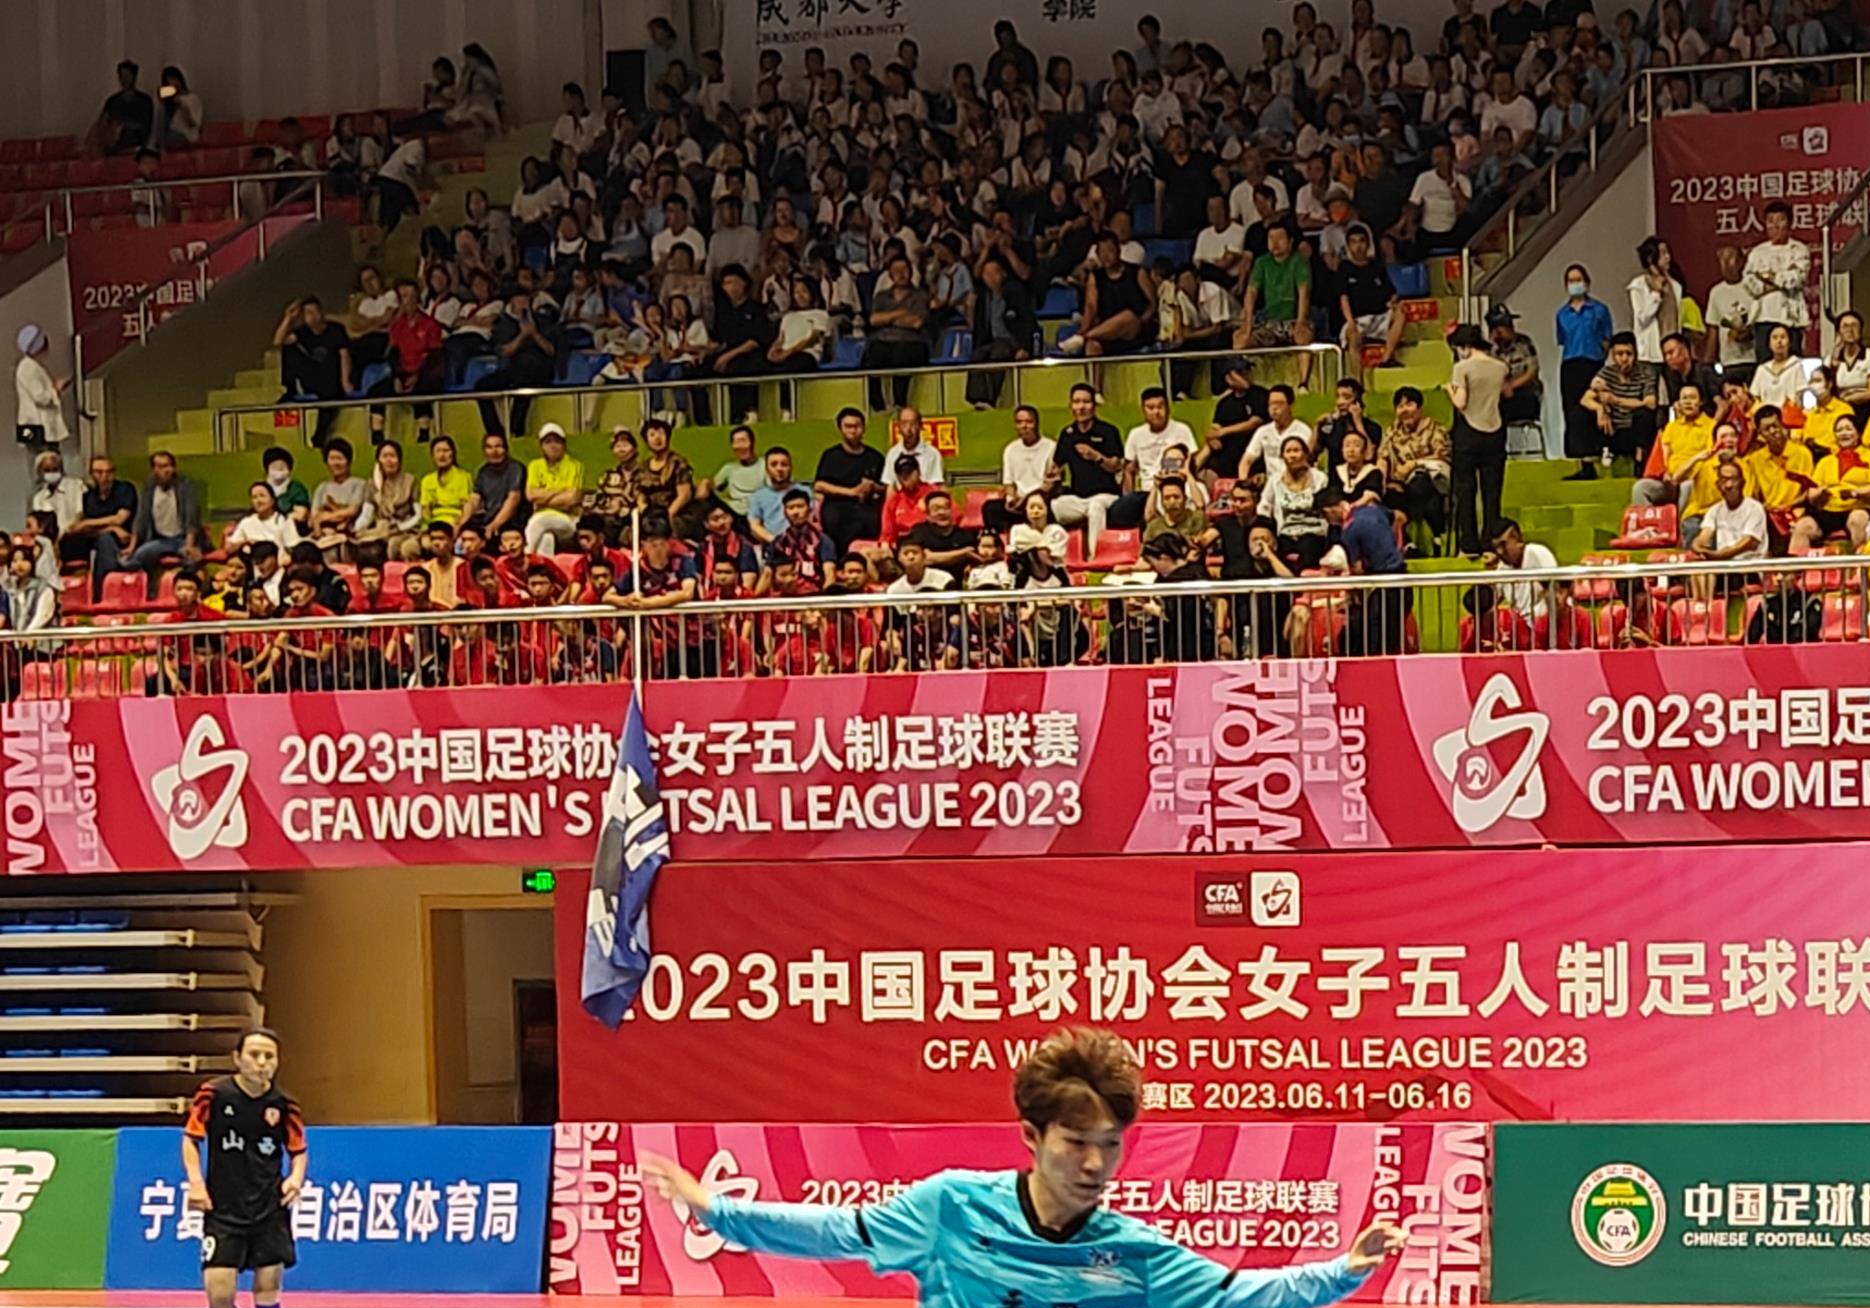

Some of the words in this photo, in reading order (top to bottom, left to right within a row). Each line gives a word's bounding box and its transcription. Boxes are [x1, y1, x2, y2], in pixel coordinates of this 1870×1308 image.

[279, 711, 1080, 785] 2023中国足球协女子五人制足球联赛
[1147, 678, 1175, 813] LEAGUE
[1340, 706, 1368, 842] LEAGUE
[73, 743, 99, 868] LEAGUE
[281, 797, 363, 841] CFA
[366, 789, 592, 840] WOMEN'S
[782, 781, 962, 831] LEAGUE
[970, 779, 1082, 828] 2023
[1588, 763, 1685, 813] CFA
[1204, 884, 1240, 902] CFA
[923, 1038, 996, 1070] CFA
[1188, 1037, 1331, 1070] FUTSAL
[1341, 1036, 1493, 1070] LEAGUE
[1502, 1036, 1588, 1069] 2023
[1203, 1081, 1472, 1111] 2023.06.11-06.16
[581, 1121, 619, 1231] FUTS
[616, 1162, 644, 1286] LEAGUE
[1157, 1217, 1258, 1249] EAGUE
[1263, 1217, 1342, 1249] 2023
[1682, 1231, 1748, 1247] CHINESE
[1755, 1231, 1835, 1247] FOOTBALL
